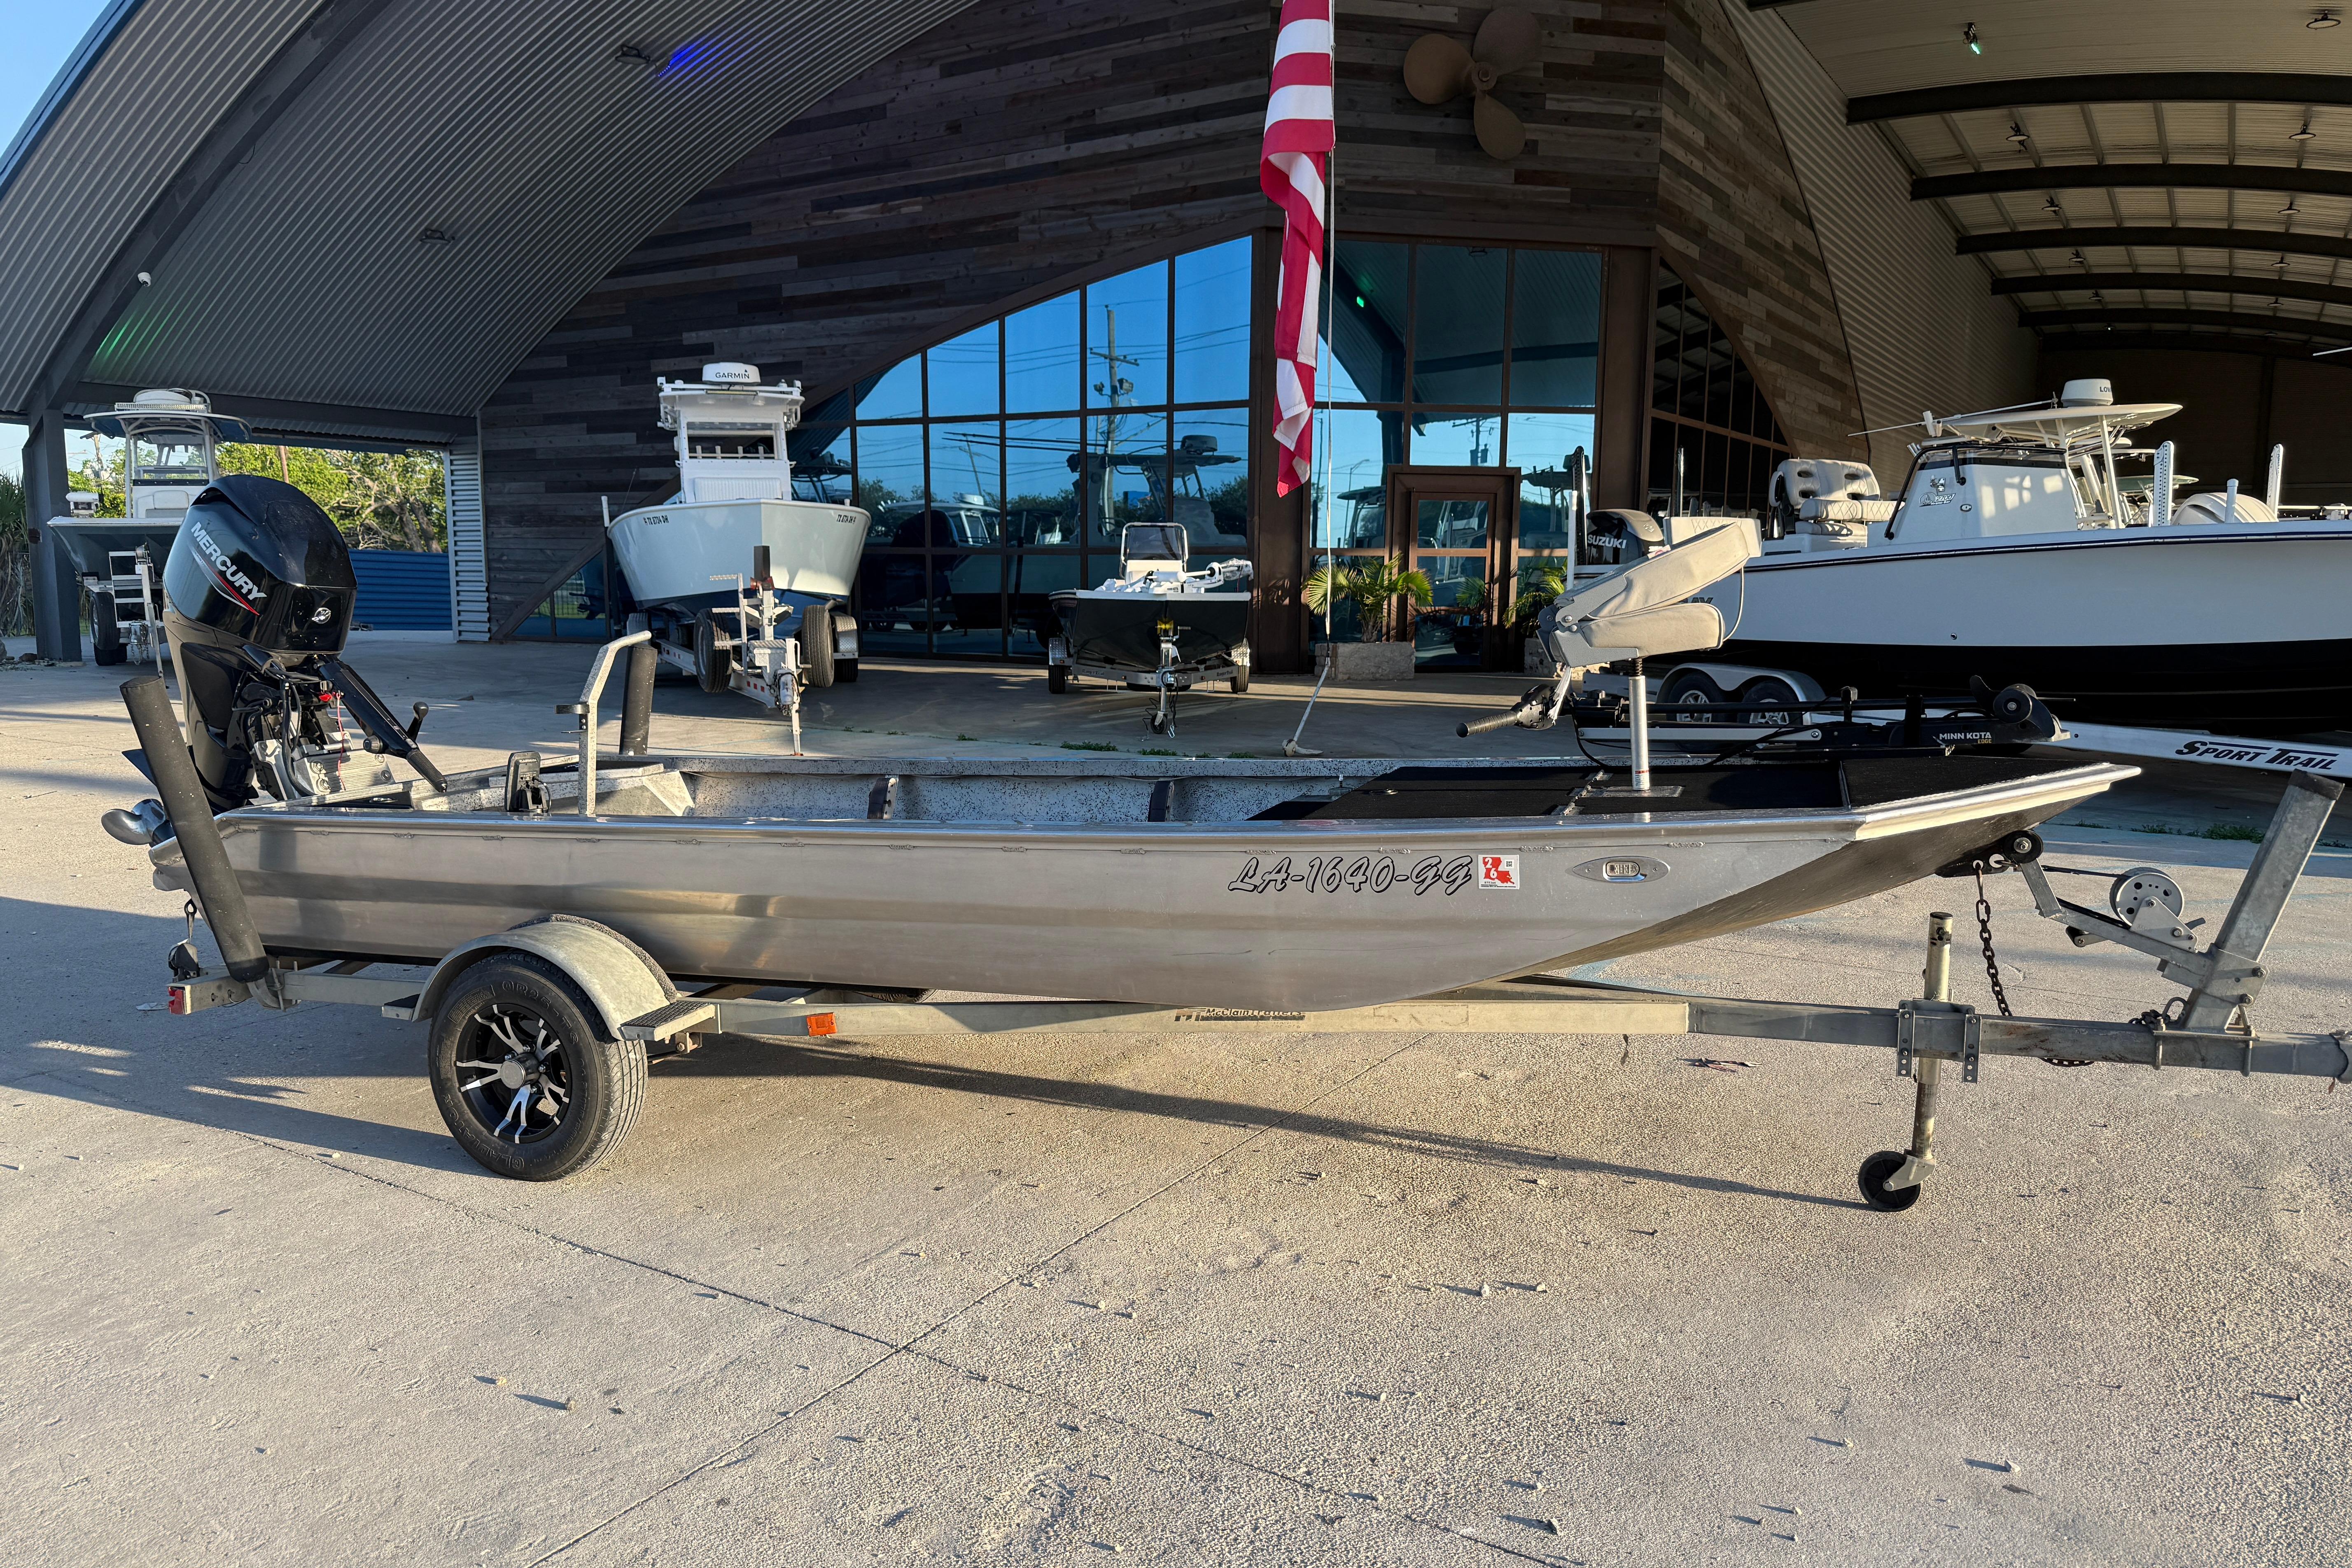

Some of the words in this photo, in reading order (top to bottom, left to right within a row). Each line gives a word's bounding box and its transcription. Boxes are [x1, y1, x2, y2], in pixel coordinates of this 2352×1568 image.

[715, 370, 750, 379] GARMIN
[1587, 534, 1626, 549] SUZUKI
[191, 522, 267, 600] MERCURY
[2175, 741, 2268, 761] SPORT
[2265, 748, 2339, 770] TRAIL
[1228, 856, 1472, 896] LA-1640-GG
